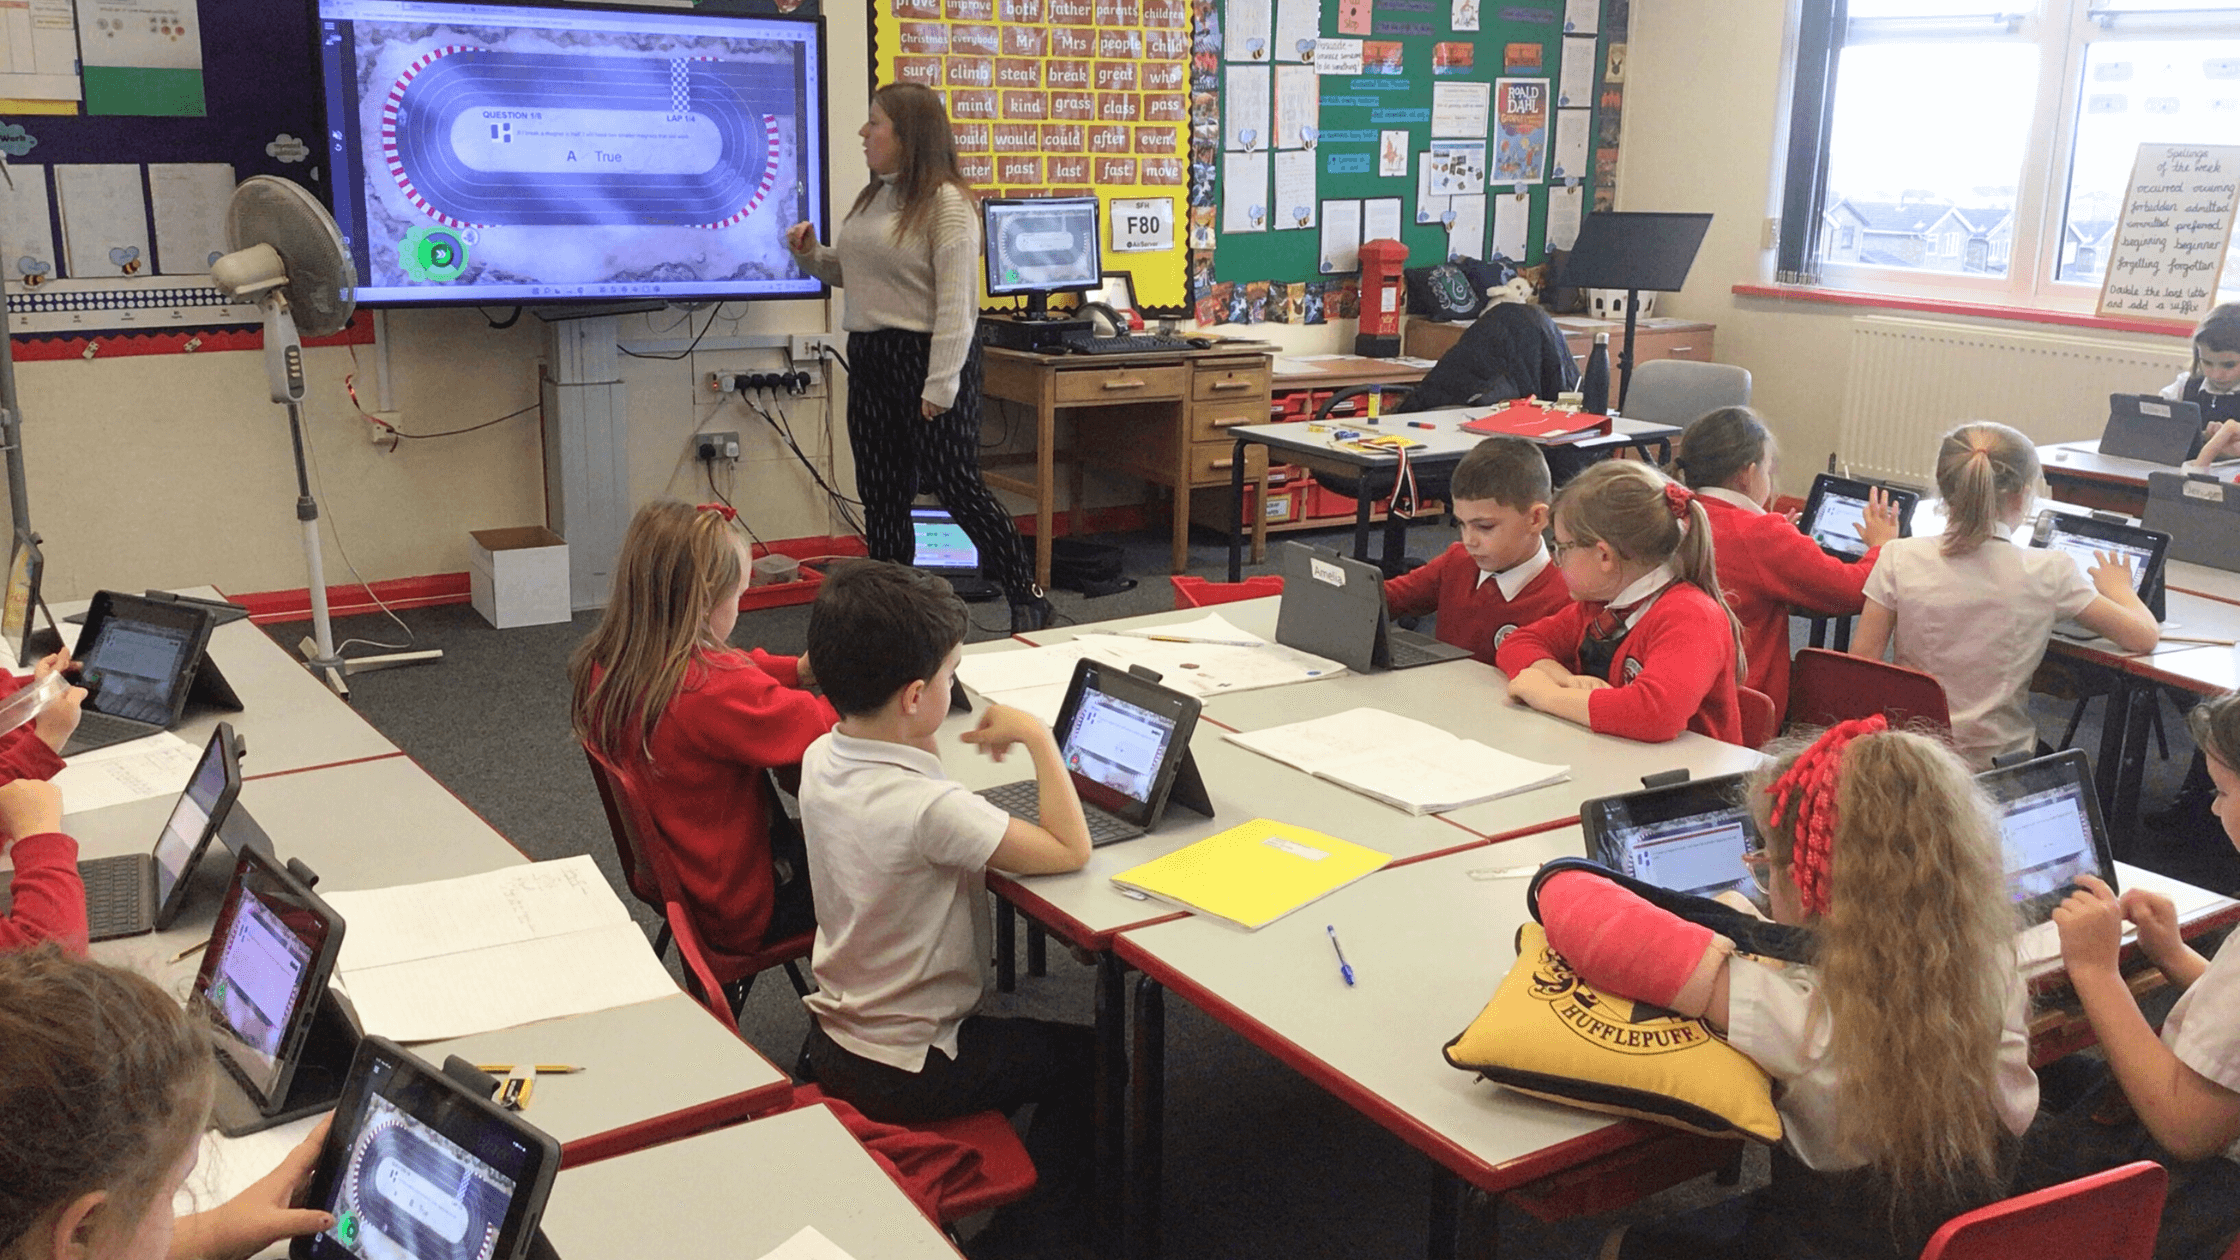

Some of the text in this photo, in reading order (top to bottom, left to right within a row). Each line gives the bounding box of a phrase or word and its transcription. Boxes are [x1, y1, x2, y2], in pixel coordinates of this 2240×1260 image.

[1006, 0, 1037, 15] both
[1049, 1, 1091, 18] father
[1096, 3, 1138, 17] parents
[1144, 8, 1184, 19] children
[901, 33, 948, 44] Christmas
[952, 34, 999, 46] everybody
[1016, 35, 1035, 48] Mr
[1062, 36, 1087, 49] Mrs
[1100, 36, 1142, 52] people
[1151, 38, 1183, 52] child
[903, 65, 934, 77] sure
[950, 64, 989, 79] climb
[1000, 65, 1036, 81] steak
[1049, 67, 1087, 82] break
[1099, 69, 1133, 84] great
[1149, 70, 1177, 84] who
[1507, 86, 1540, 99] ROALD
[957, 98, 993, 112] mind
[1010, 98, 1041, 112] kind
[1055, 98, 1091, 112] grass
[1103, 100, 1136, 114] class
[1151, 100, 1180, 114] pass
[1507, 99, 1539, 114] DAHL
[482, 110, 528, 120] QUESTION
[666, 114, 682, 122] LAP
[995, 131, 1037, 145] would
[1045, 131, 1081, 145] could
[1093, 131, 1126, 148] after
[566, 150, 622, 163] A True
[2166, 147, 2209, 164] Spellings
[962, 164, 991, 177] ater
[1005, 162, 1035, 178] past
[1056, 163, 1082, 177] last
[1103, 162, 1129, 179] fast
[1146, 165, 1179, 177] move
[2157, 160, 2221, 177] of the week
[2131, 200, 2231, 215] forbidden admitted
[1127, 215, 1160, 235] F80
[2126, 216, 2170, 228] committed
[2121, 236, 2221, 255] beginning beginner
[2117, 256, 2215, 278] forgetting forgotten
[2109, 284, 2140, 297] Double
[2143, 286, 2160, 297] the
[2162, 287, 2183, 298] last
[2106, 299, 2199, 315] and add a suffix
